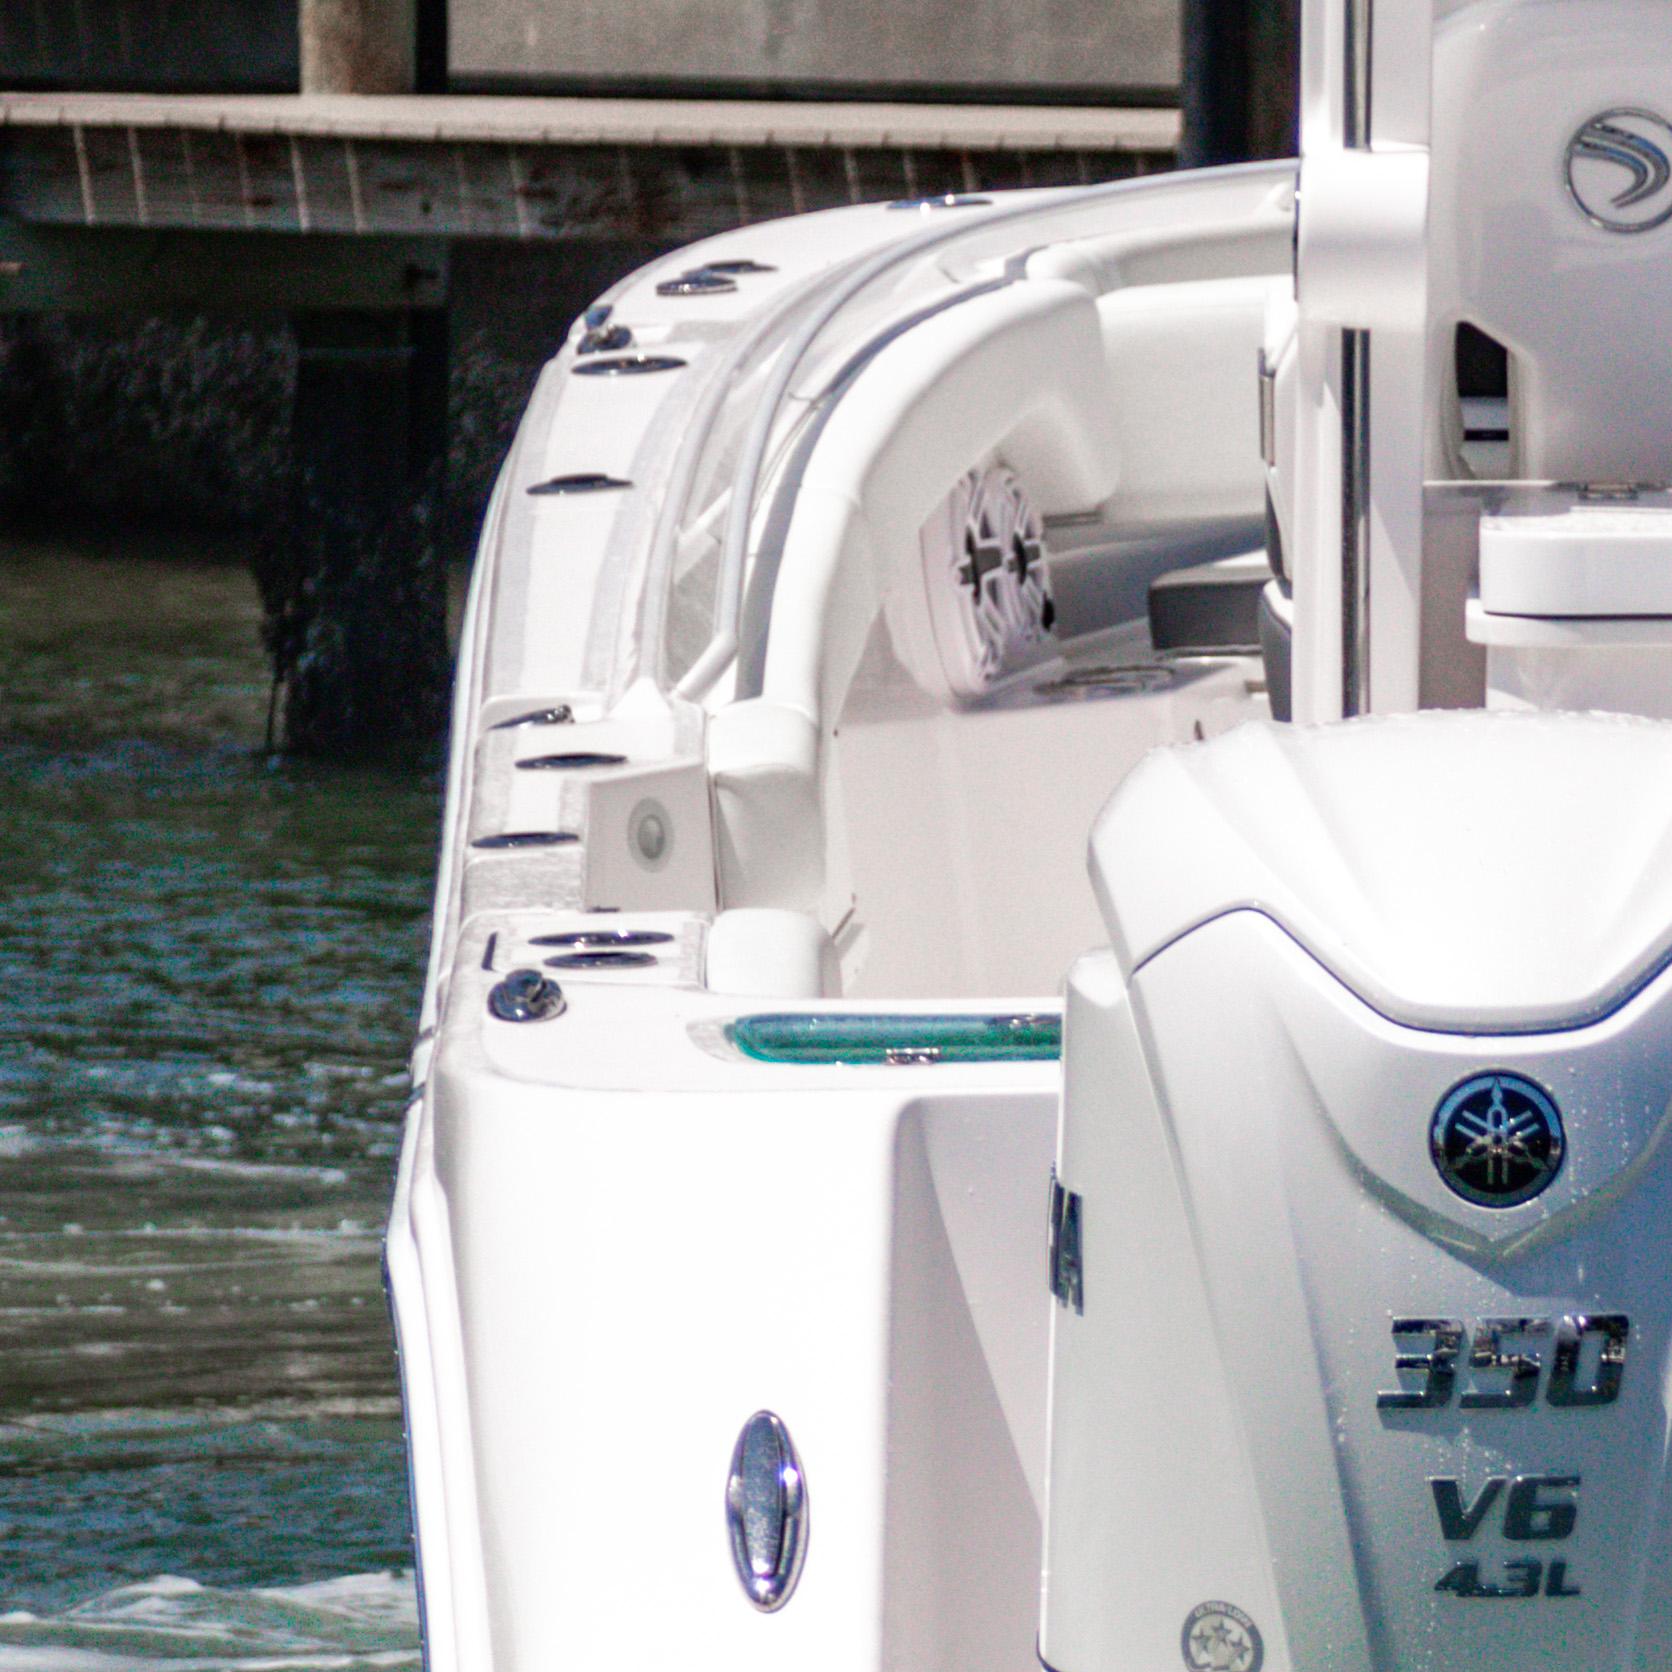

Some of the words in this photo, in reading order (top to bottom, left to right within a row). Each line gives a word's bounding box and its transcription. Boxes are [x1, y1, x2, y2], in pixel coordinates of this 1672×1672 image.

[1376, 1314, 1630, 1409] 350
[1426, 1475, 1581, 1540] V6
[1434, 1558, 1581, 1598] 4.3L
